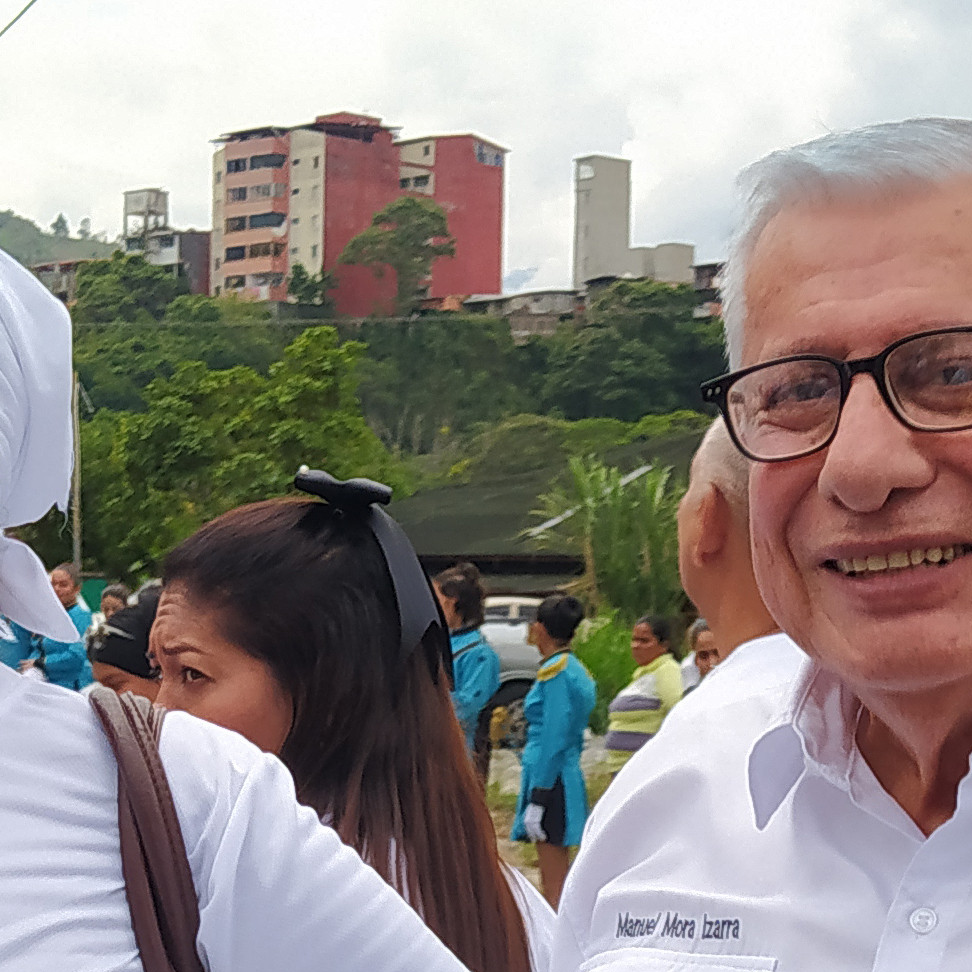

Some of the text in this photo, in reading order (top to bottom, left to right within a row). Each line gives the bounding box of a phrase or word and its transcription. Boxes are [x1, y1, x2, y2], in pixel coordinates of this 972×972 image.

[615, 911, 740, 939] Manuel Mora Izarra
